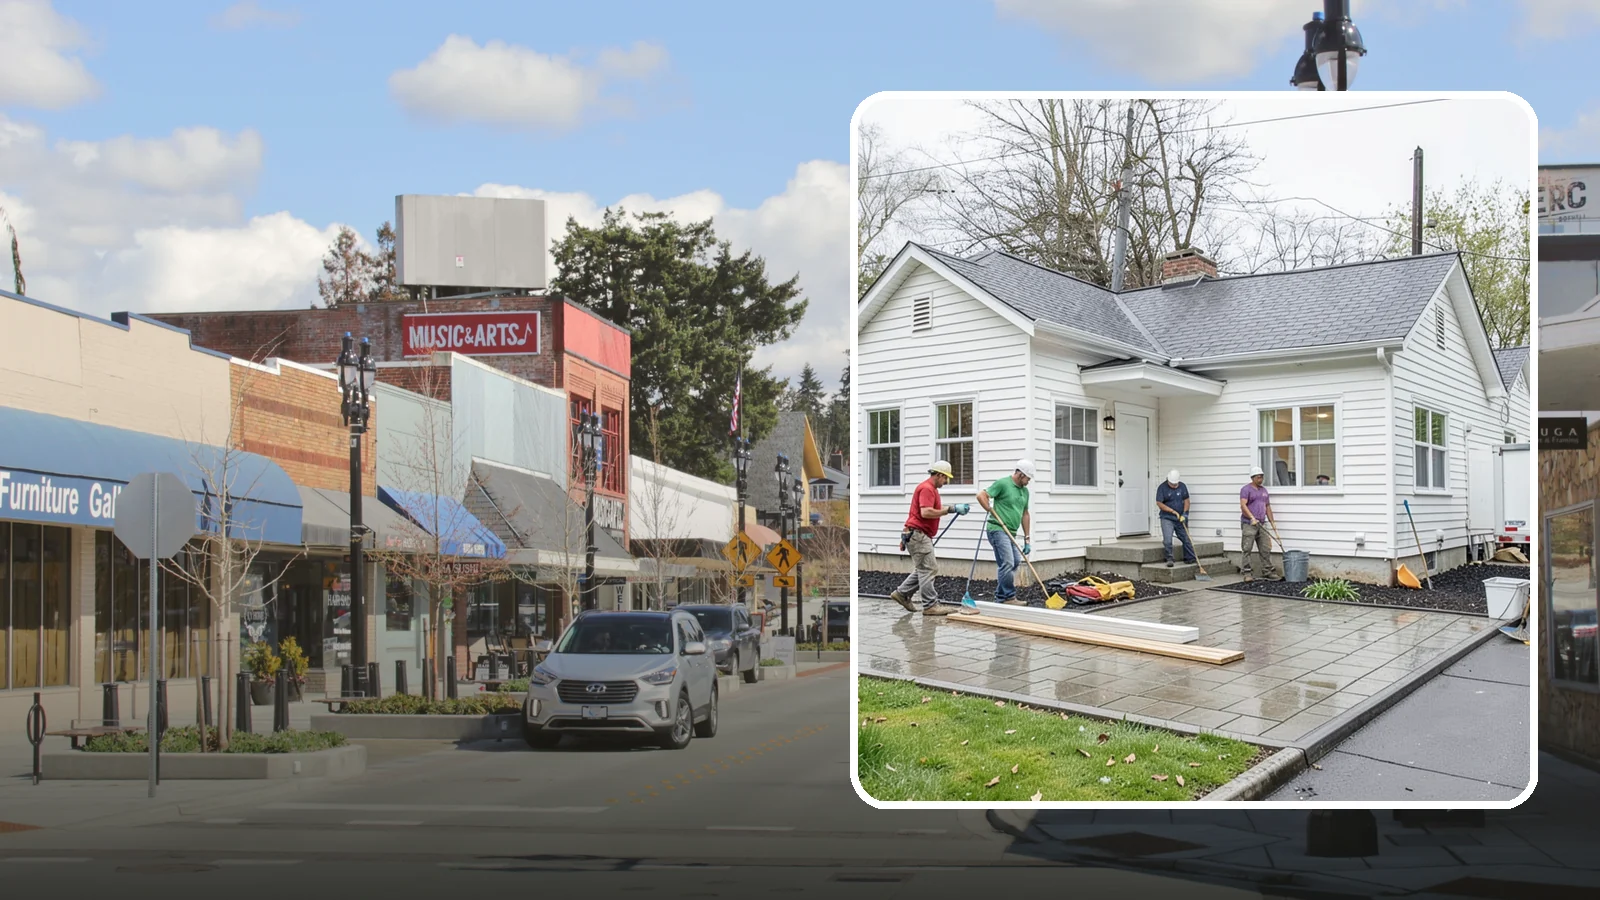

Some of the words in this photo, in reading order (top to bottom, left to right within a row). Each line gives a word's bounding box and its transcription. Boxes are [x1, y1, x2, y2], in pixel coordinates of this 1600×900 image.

[0, 471, 79, 515] Furniture
[89, 482, 122, 519] Gal
[453, 563, 479, 574] SUSHI
